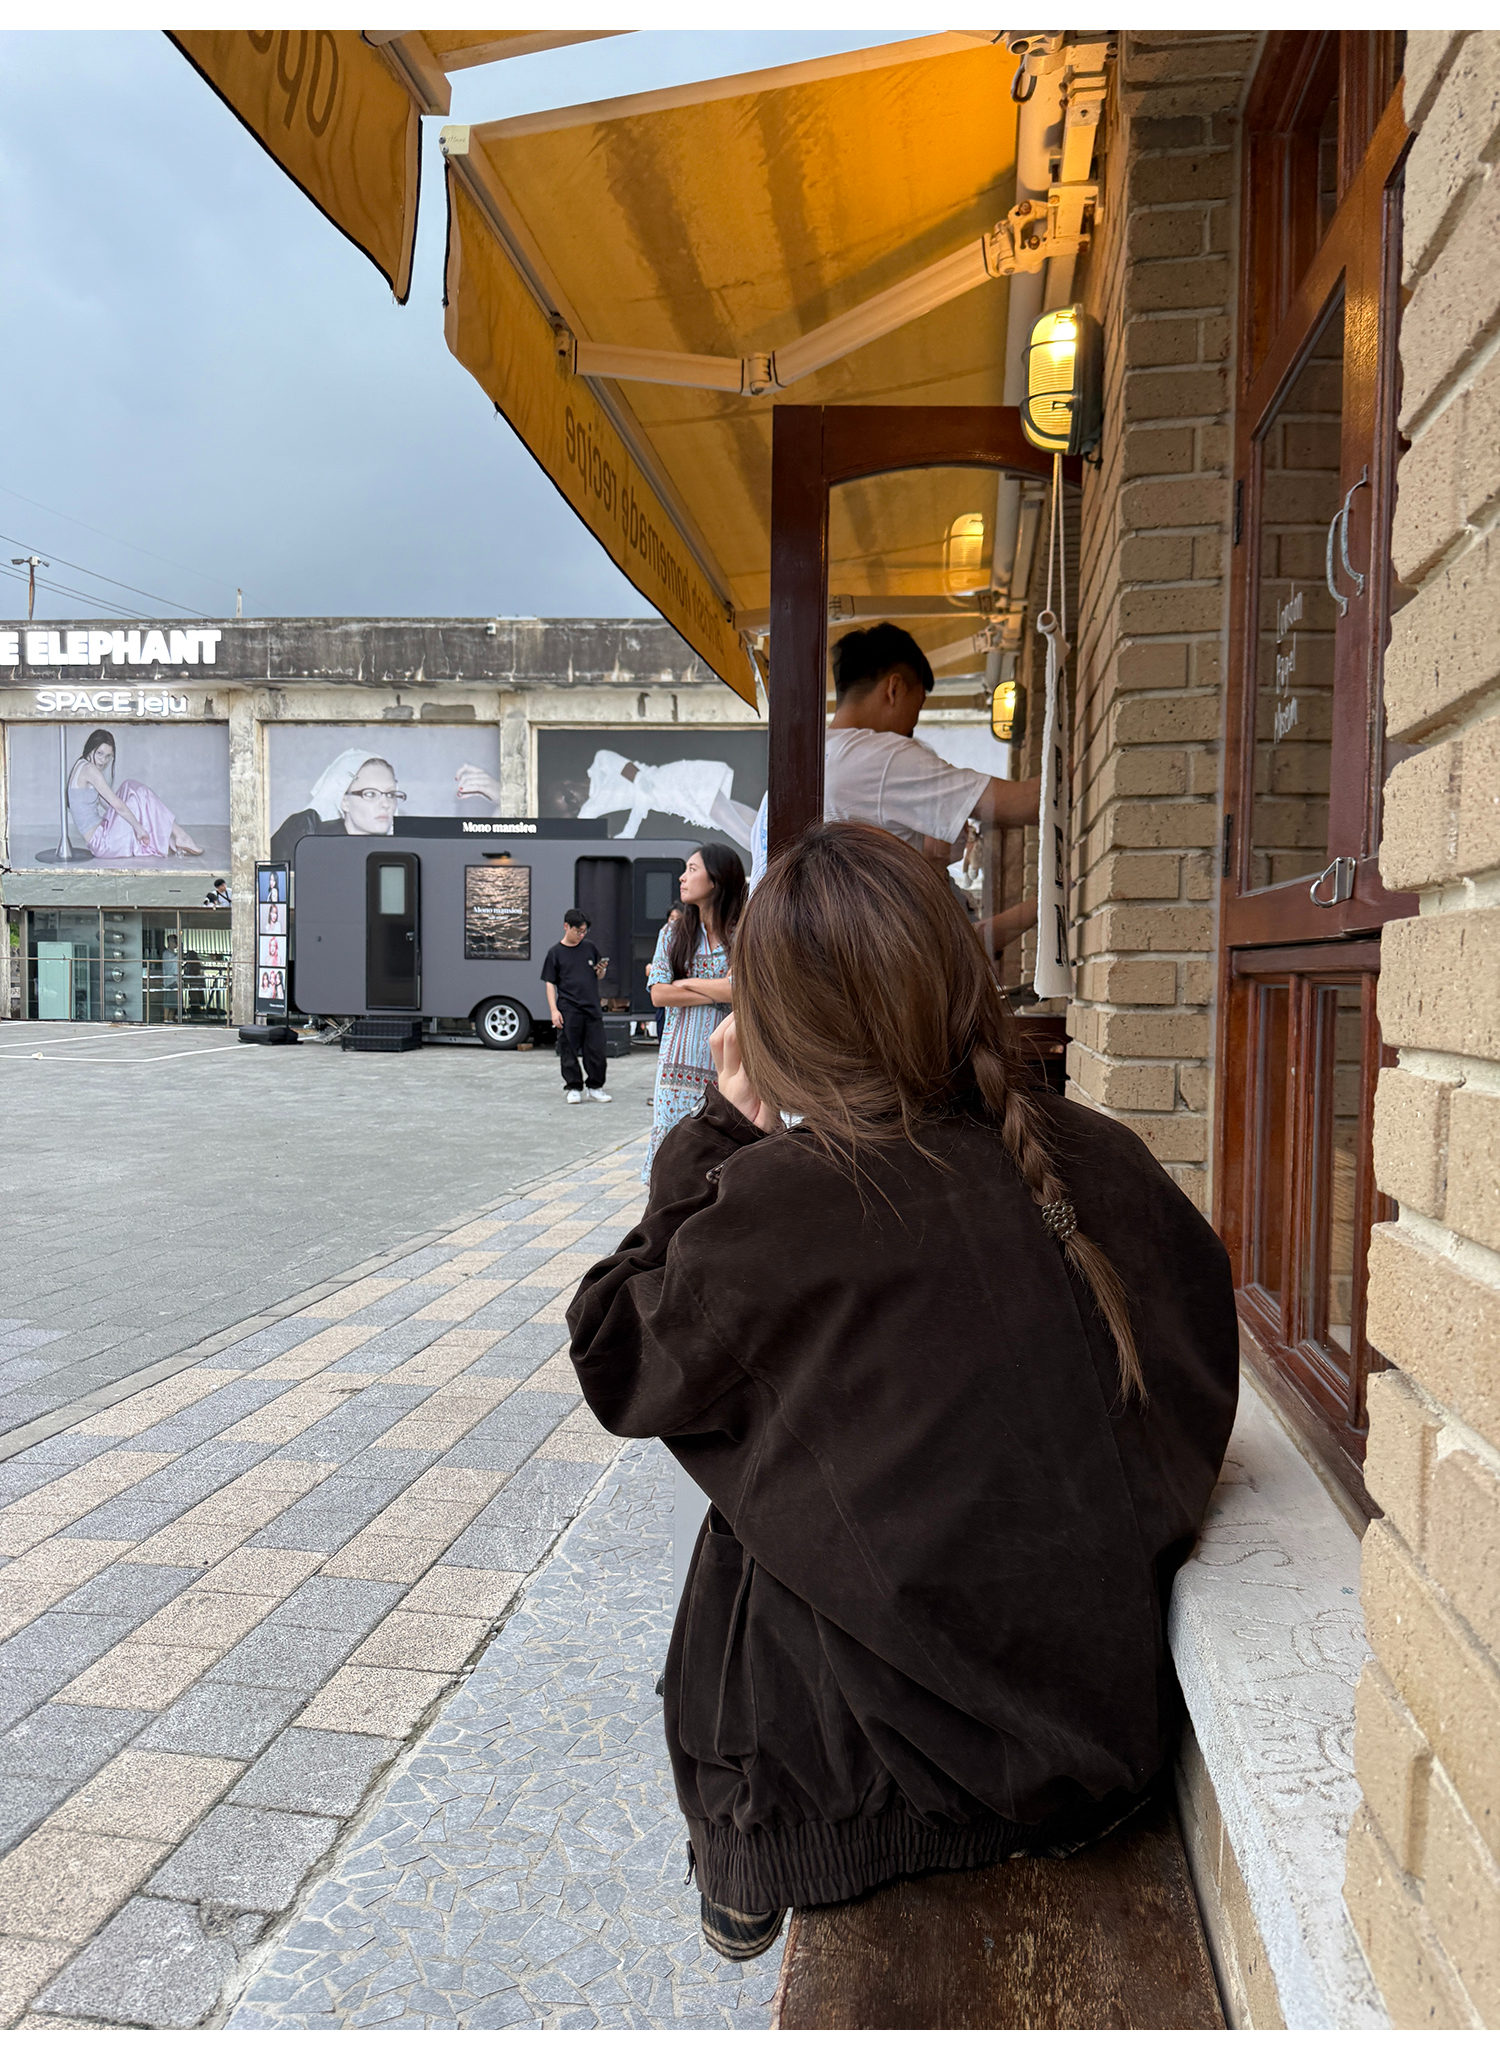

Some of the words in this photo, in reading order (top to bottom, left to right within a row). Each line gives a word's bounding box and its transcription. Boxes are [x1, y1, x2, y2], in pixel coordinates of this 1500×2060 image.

[26, 629, 222, 666] ELEPHANT
[35, 690, 132, 713] SPACE
[137, 690, 188, 717] jeju
[462, 821, 491, 833] Mono
[492, 821, 537, 834] mansion
